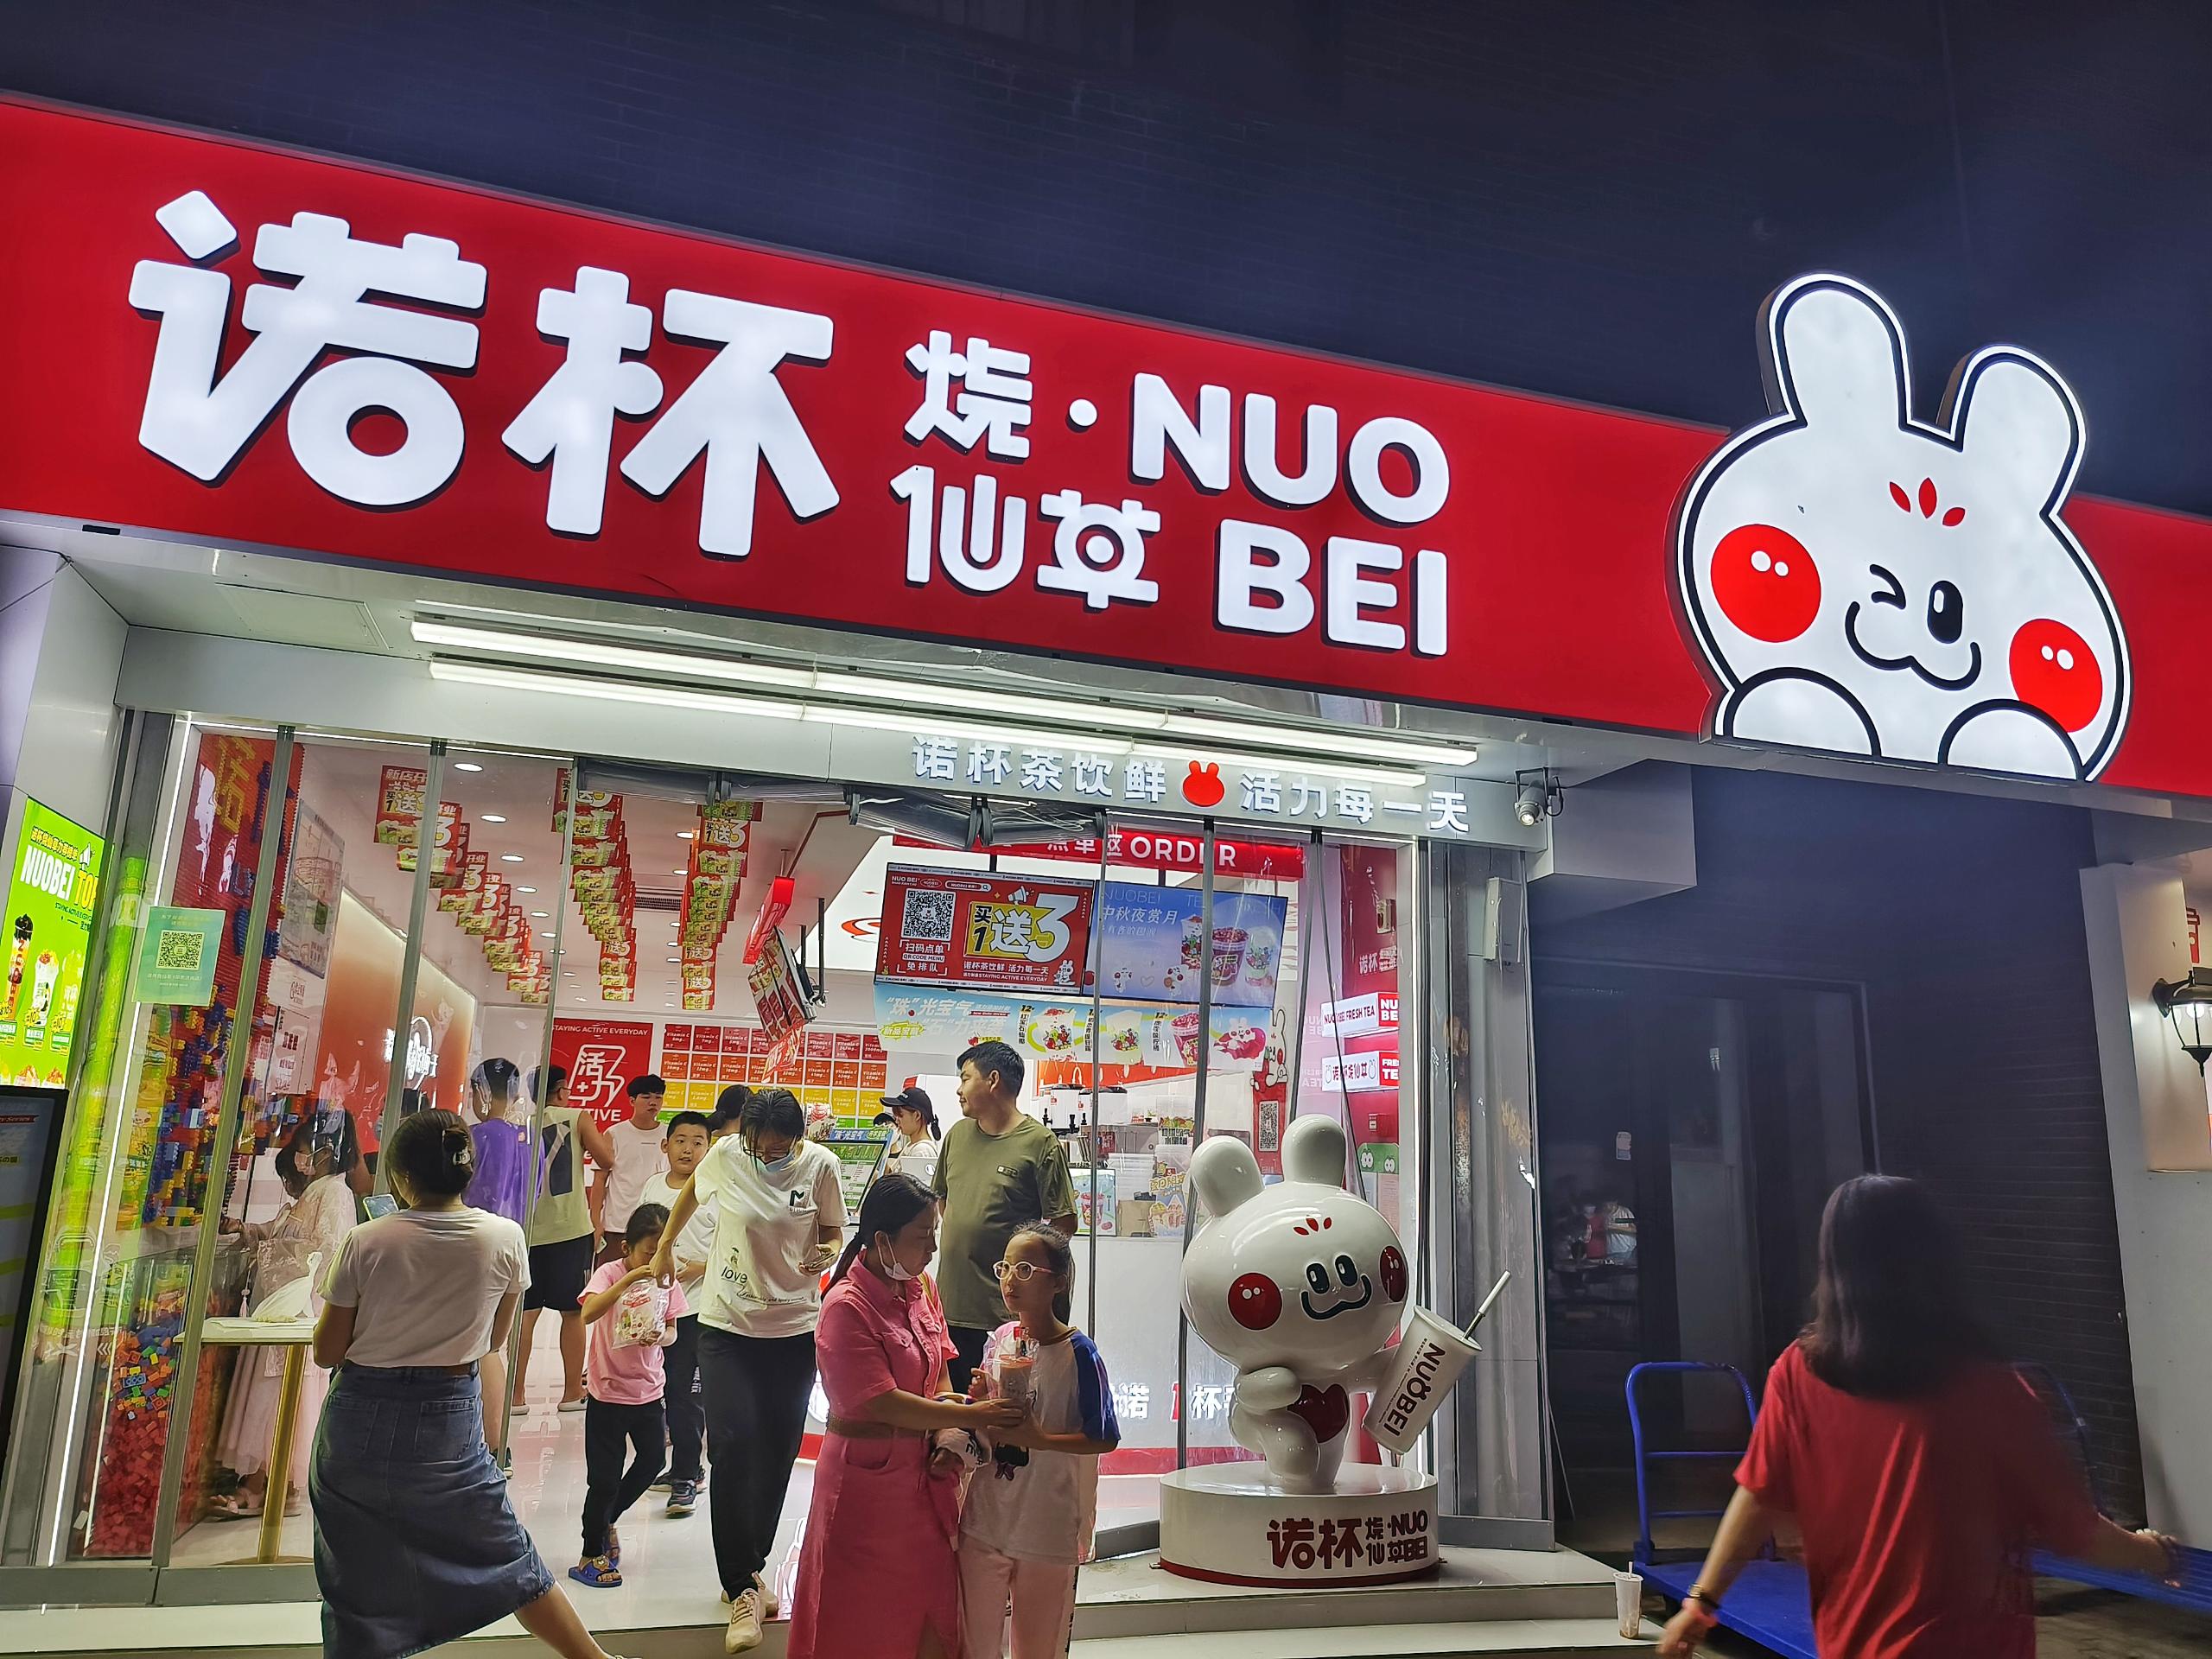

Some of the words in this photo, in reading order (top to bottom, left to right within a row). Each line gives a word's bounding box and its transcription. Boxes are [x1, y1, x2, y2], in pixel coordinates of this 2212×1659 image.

[129, 190, 840, 557] 诺杯
[905, 330, 1033, 459] 烧
[1131, 372, 1450, 524] NUO
[889, 465, 1161, 609] 仙草
[1217, 518, 1447, 656] BEI
[386, 768, 428, 783] 新店开
[911, 733, 1167, 804] 诺杯茶饮鲜
[1239, 769, 1470, 834] 活力每一天
[20, 845, 76, 901] NUOBEI
[974, 905, 992, 924] 买
[905, 942, 944, 954] 扫码点单
[906, 962, 938, 973] 免排队
[1008, 963, 1049, 975] 活力每一天
[1381, 999, 1399, 1010] NU
[1345, 1008, 1363, 1020] FRESH
[1363, 1006, 1376, 1018] TEA
[1381, 1010, 1399, 1021] BE
[1382, 1058, 1399, 1067] FRE
[1382, 1069, 1399, 1080] TE
[589, 1109, 622, 1122] TIVE
[721, 1266, 748, 1284] love
[1383, 1342, 1446, 1437] NUOBEI
[1267, 1517, 1364, 1571] 诺杯
[1390, 1509, 1428, 1538] NUO
